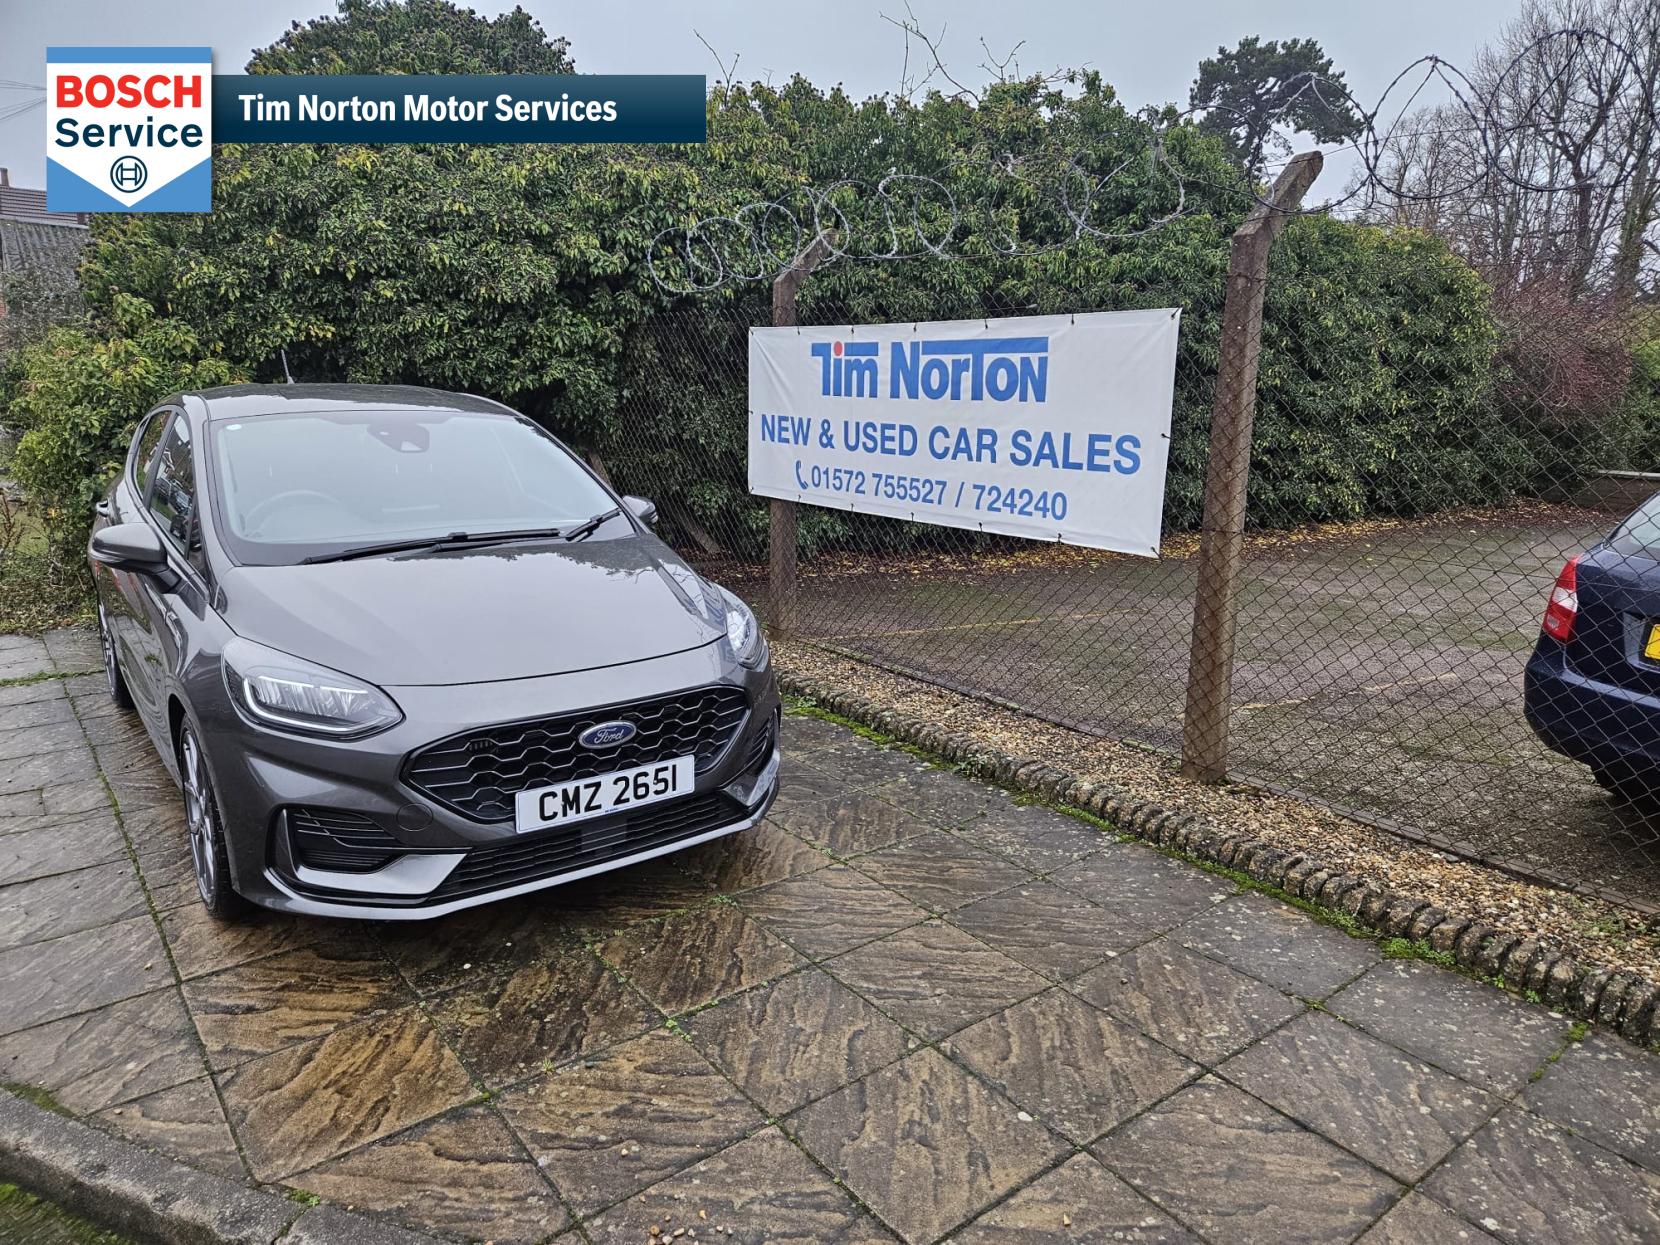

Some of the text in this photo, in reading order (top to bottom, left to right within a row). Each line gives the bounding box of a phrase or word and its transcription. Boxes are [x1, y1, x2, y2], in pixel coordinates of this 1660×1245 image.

[811, 341, 879, 398] Tim
[761, 414, 1141, 474] NEW & USED CAR SALES
[811, 465, 1067, 520] 01572 755527 / 724240
[594, 727, 624, 744] Ford
[539, 764, 677, 821] CMZ 2651
